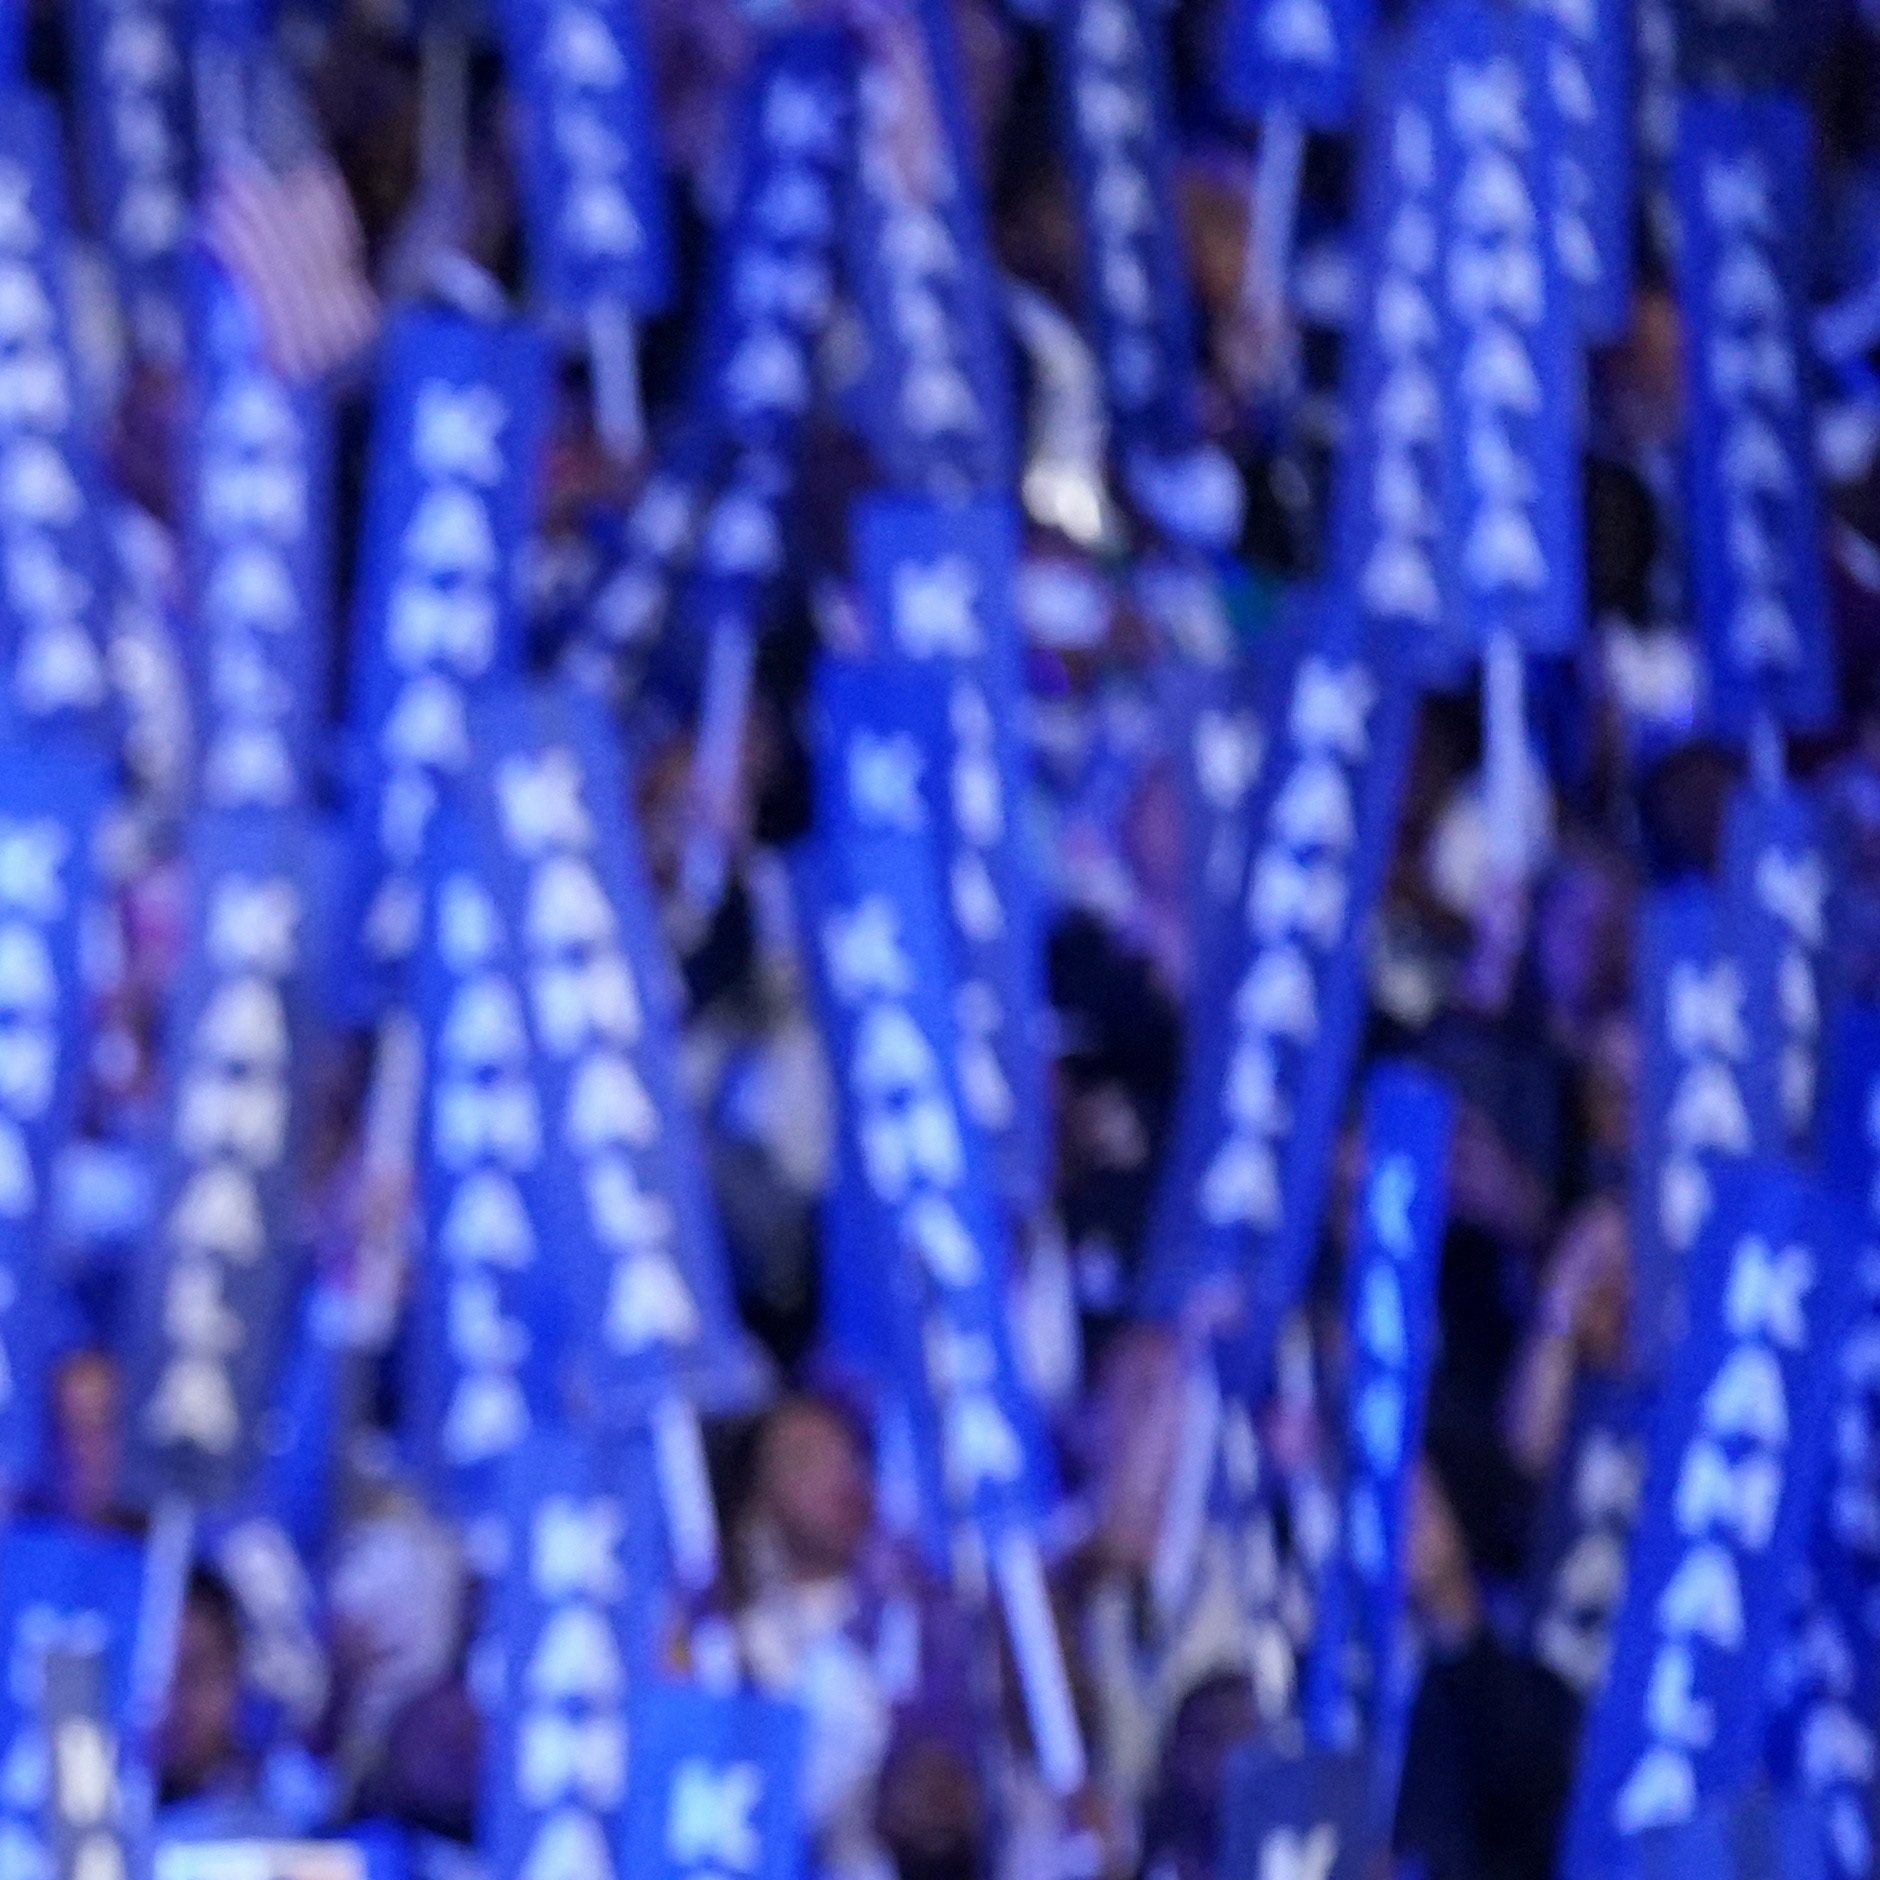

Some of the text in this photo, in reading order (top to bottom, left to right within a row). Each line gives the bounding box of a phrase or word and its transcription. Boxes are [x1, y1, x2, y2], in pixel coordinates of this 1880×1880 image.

[1448, 65, 1545, 595] KAMALA
[496, 752, 700, 1348] KAMALA
[1200, 655, 1375, 1228] KAMALA
[1620, 1237, 1815, 1830] KAMALA
